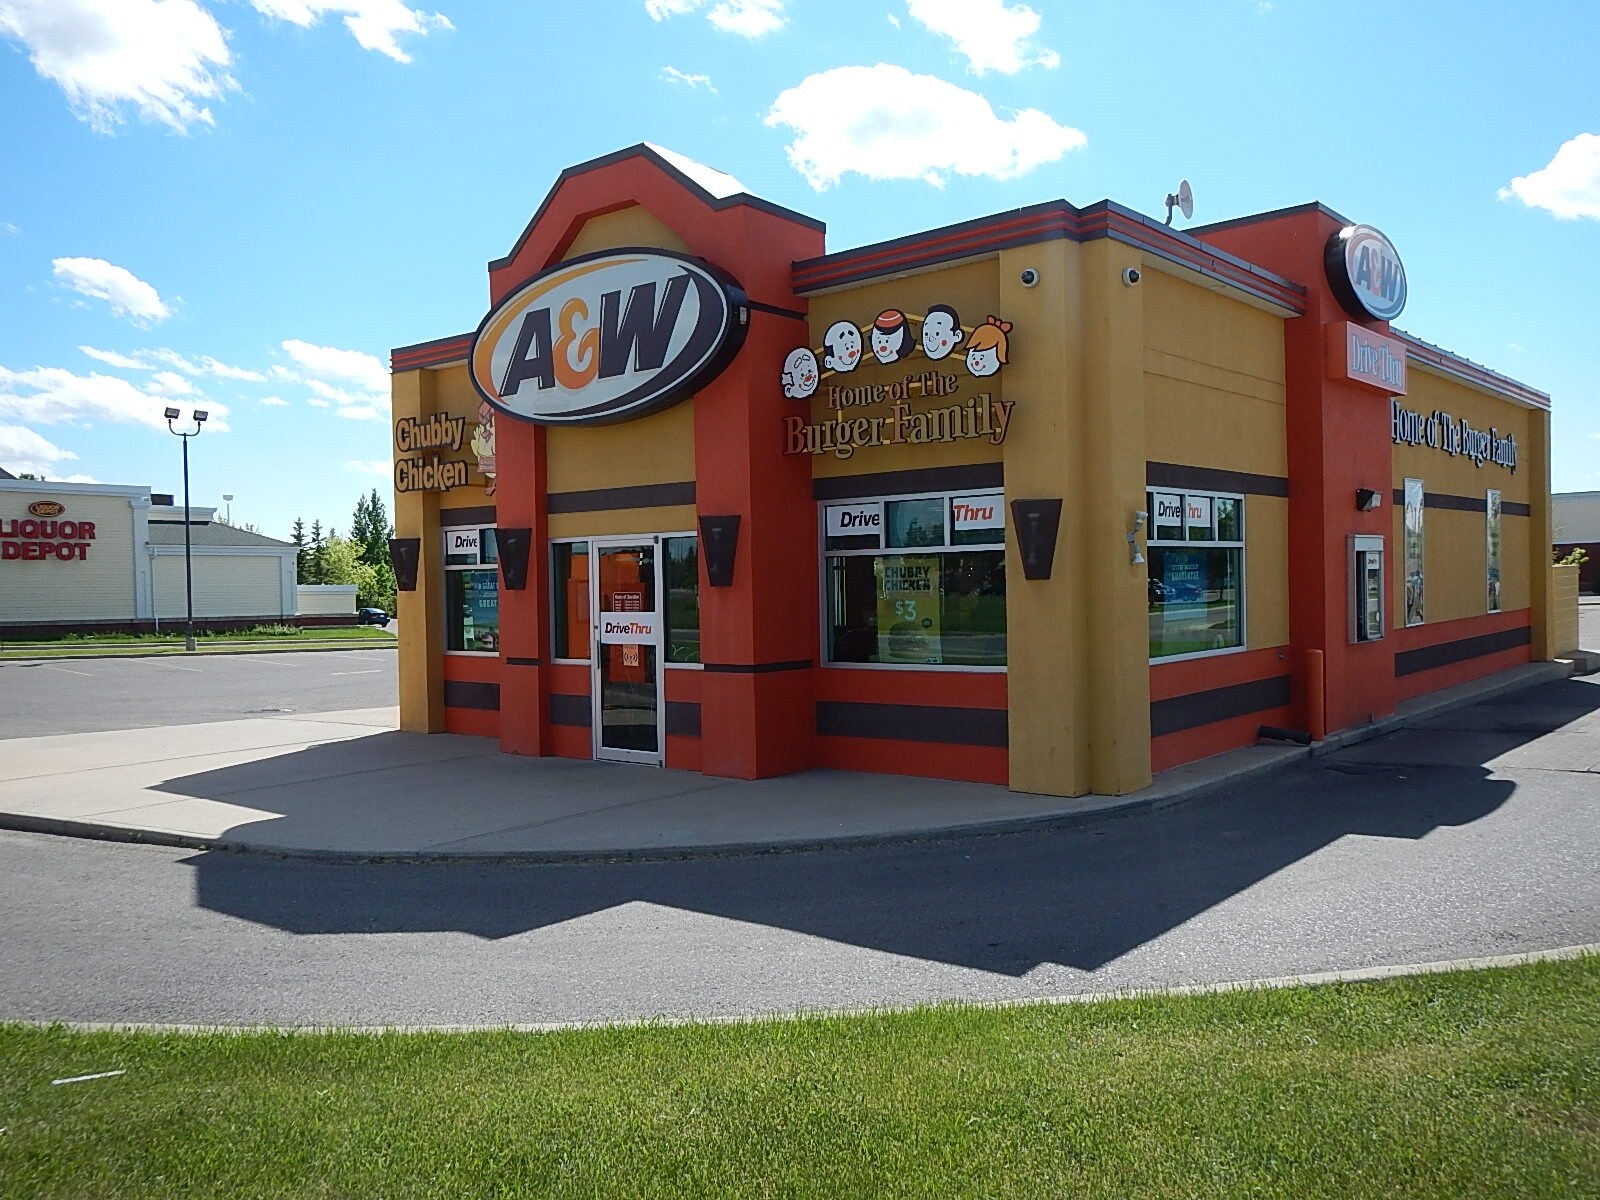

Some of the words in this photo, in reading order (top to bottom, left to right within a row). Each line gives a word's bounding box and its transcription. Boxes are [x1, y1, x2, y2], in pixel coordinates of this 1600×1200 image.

[1356, 245, 1400, 302] A&W
[498, 273, 692, 397] A&W
[1352, 334, 1378, 376] Drive
[1380, 343, 1403, 387] Thru
[826, 384, 886, 411] Home
[887, 374, 915, 400] of
[916, 371, 959, 397] The
[396, 412, 465, 453] Chubby
[783, 416, 886, 459] Burger
[890, 393, 1015, 446] Family
[1391, 398, 1425, 447] Home
[1425, 408, 1440, 449] of
[1440, 411, 1461, 457] The
[1460, 418, 1491, 469] Burger
[1490, 427, 1518, 475] Family
[394, 456, 468, 493] Chicken
[840, 510, 880, 528] Drive
[953, 504, 994, 522] Thru
[1158, 500, 1181, 518] Drive
[1188, 503, 1202, 519] hru
[0, 519, 96, 539] LIQUOR
[2, 541, 91, 561] DEPOT
[884, 566, 931, 578] CHUBBY
[884, 579, 931, 591] CHICKEN
[895, 600, 917, 621] $3
